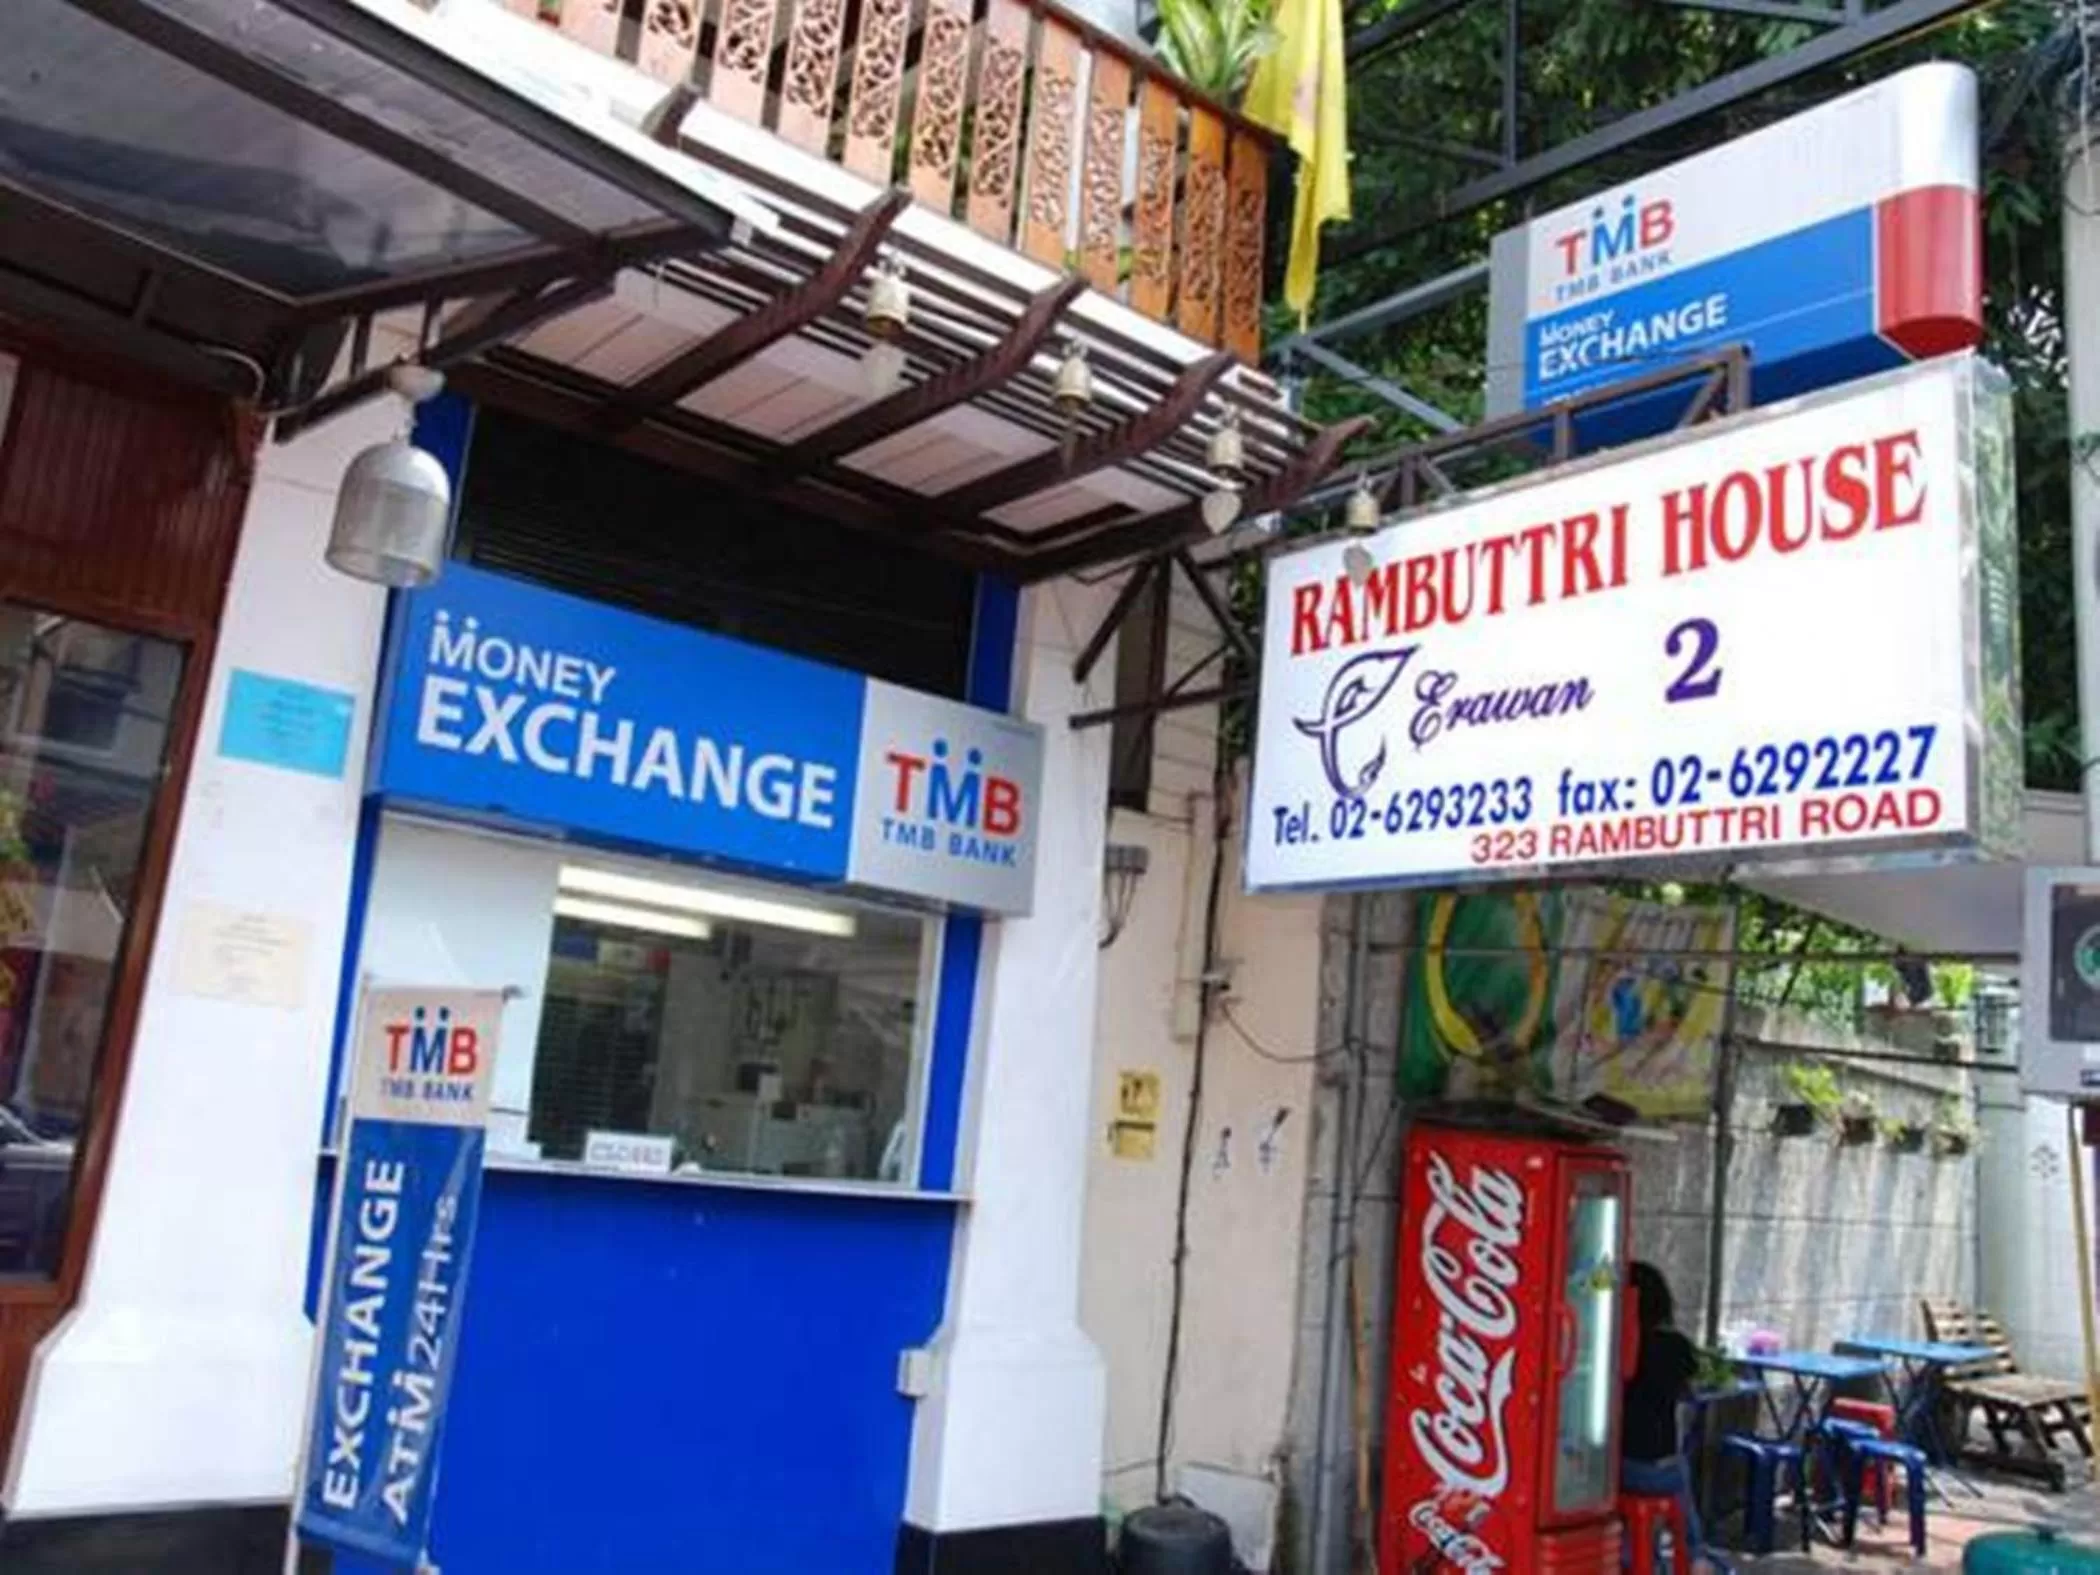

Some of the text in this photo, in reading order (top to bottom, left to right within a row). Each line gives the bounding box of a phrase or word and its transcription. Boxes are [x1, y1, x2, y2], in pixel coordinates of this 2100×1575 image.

[1555, 250, 1673, 302] TMB BANK
[1556, 195, 1675, 276] TMB
[1539, 292, 1729, 380] EXCHANGE
[1540, 308, 1616, 348] MONEY
[1290, 429, 1928, 658] RAMBUTTRI HOUSE
[428, 609, 617, 705] MONEY
[1664, 617, 1723, 704] 2
[416, 673, 838, 830] EXCHANGE
[1408, 669, 1596, 751] Erawan
[886, 738, 1021, 837] TMB
[1273, 725, 1938, 847] Tel. 02-6293233 fax: 02-6292227
[1470, 787, 1942, 864] 323 RAMBUTTRI ROAD
[883, 817, 1018, 868] TMB BANK
[385, 1006, 477, 1075] TMB
[422, 1081, 474, 1103] BANK
[323, 1159, 405, 1510] EXCHANGE
[382, 1194, 459, 1526] ATM 24Hrs
[1410, 1150, 1526, 1498] Coca-Cola
